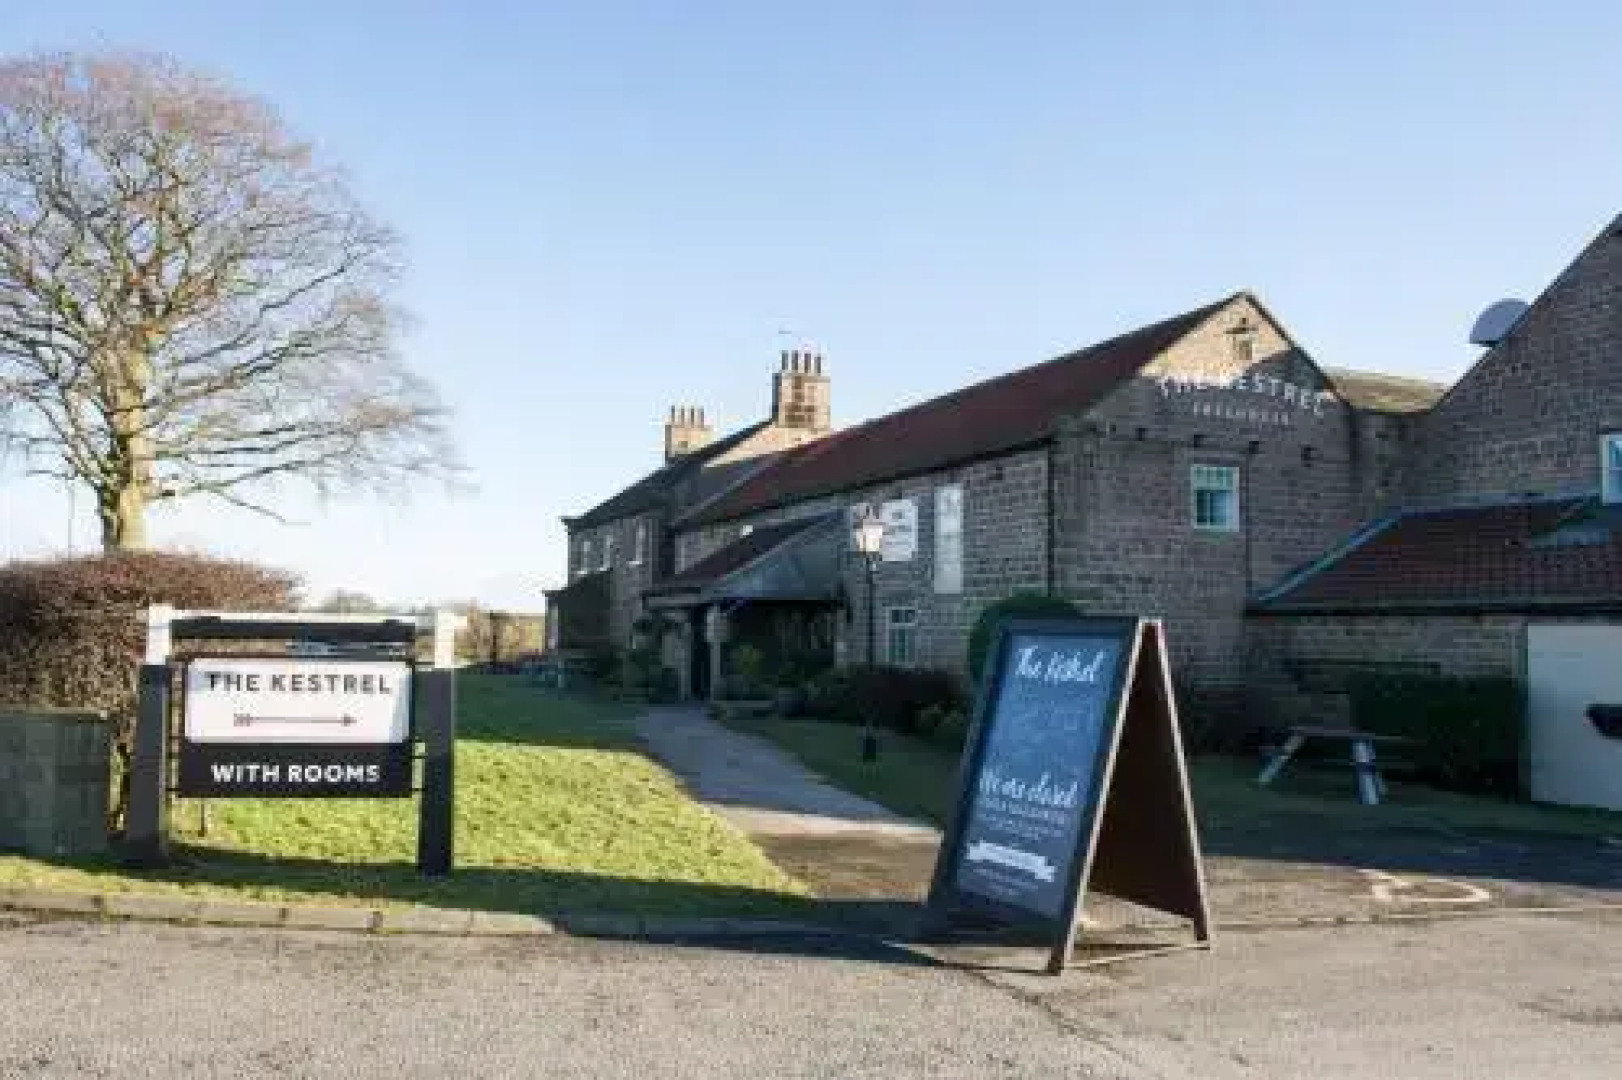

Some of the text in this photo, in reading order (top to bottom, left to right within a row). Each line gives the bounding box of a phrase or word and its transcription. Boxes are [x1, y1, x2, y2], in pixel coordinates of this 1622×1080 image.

[208, 673, 393, 694] THE KESTREL
[210, 764, 382, 783] WITH ROOMS
